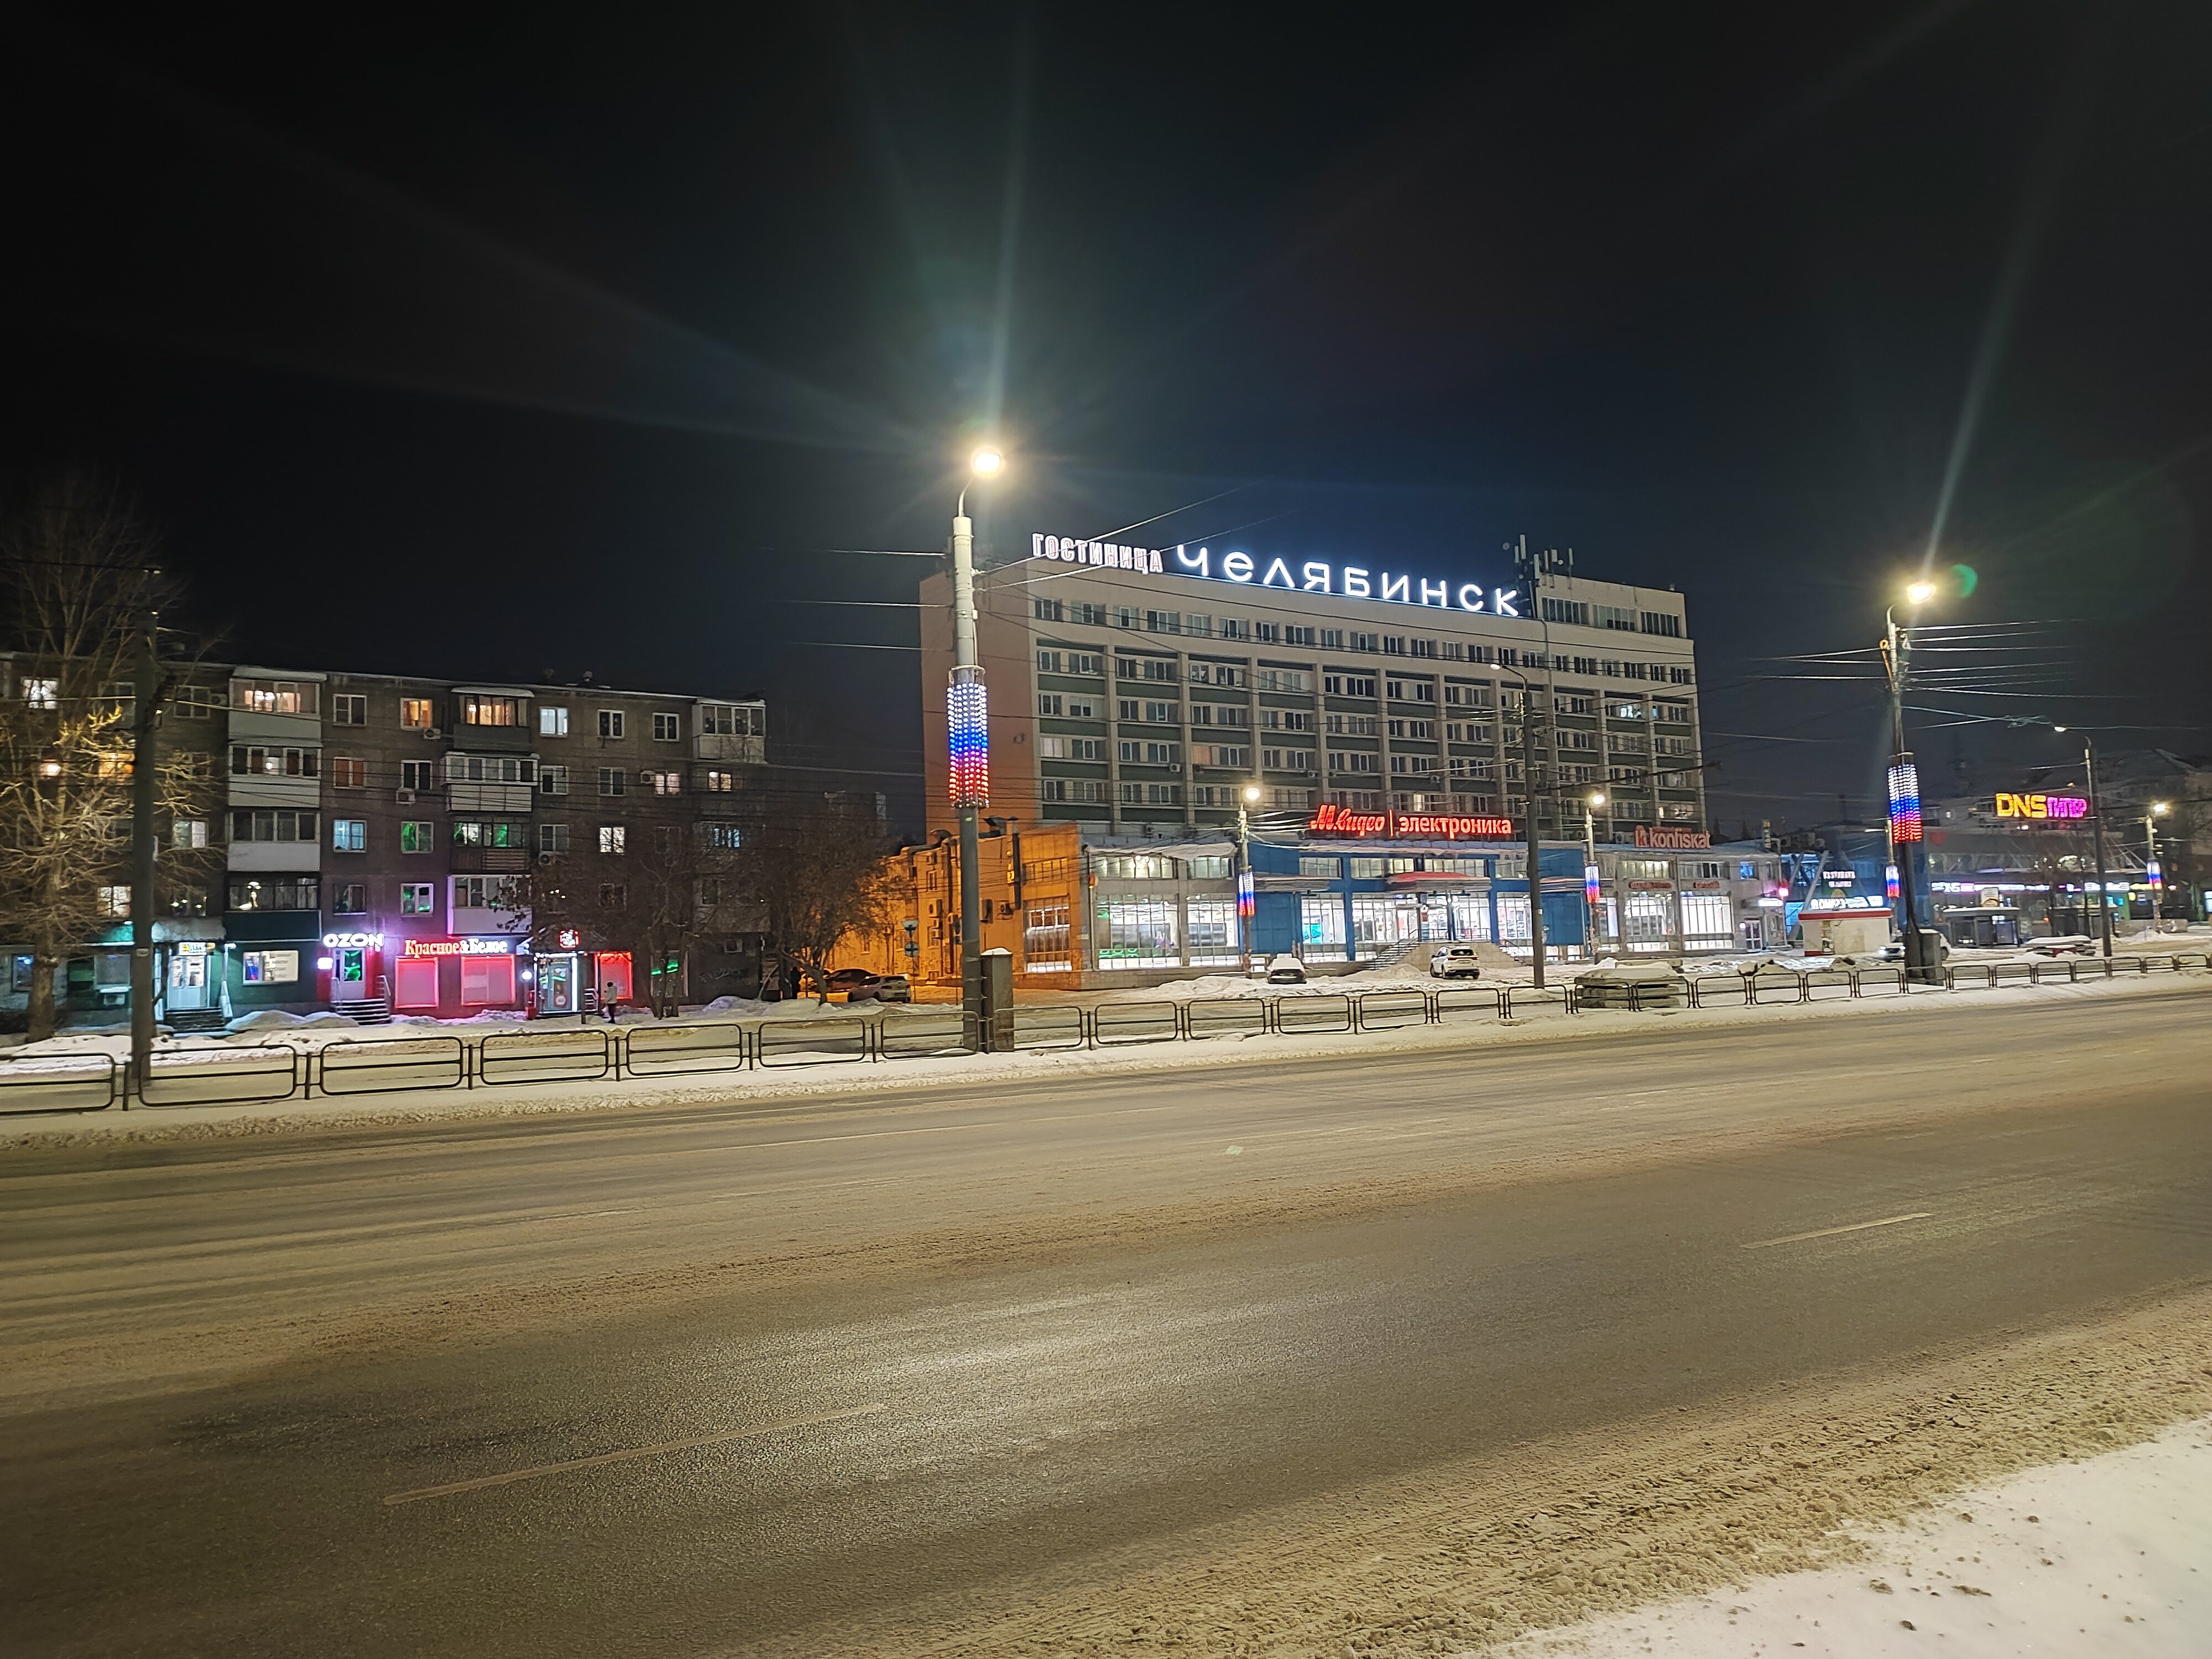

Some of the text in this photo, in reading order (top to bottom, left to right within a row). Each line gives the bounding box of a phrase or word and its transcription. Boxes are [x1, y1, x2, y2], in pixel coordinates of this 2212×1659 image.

[1032, 533, 1520, 617] ГОСТИНИЦА ЧЕЛЯБИНСК
[1996, 793, 2047, 818] DNS
[1310, 805, 1512, 839] М.видео электроника
[1649, 827, 1710, 849] konfiskat
[323, 933, 384, 947] OZON
